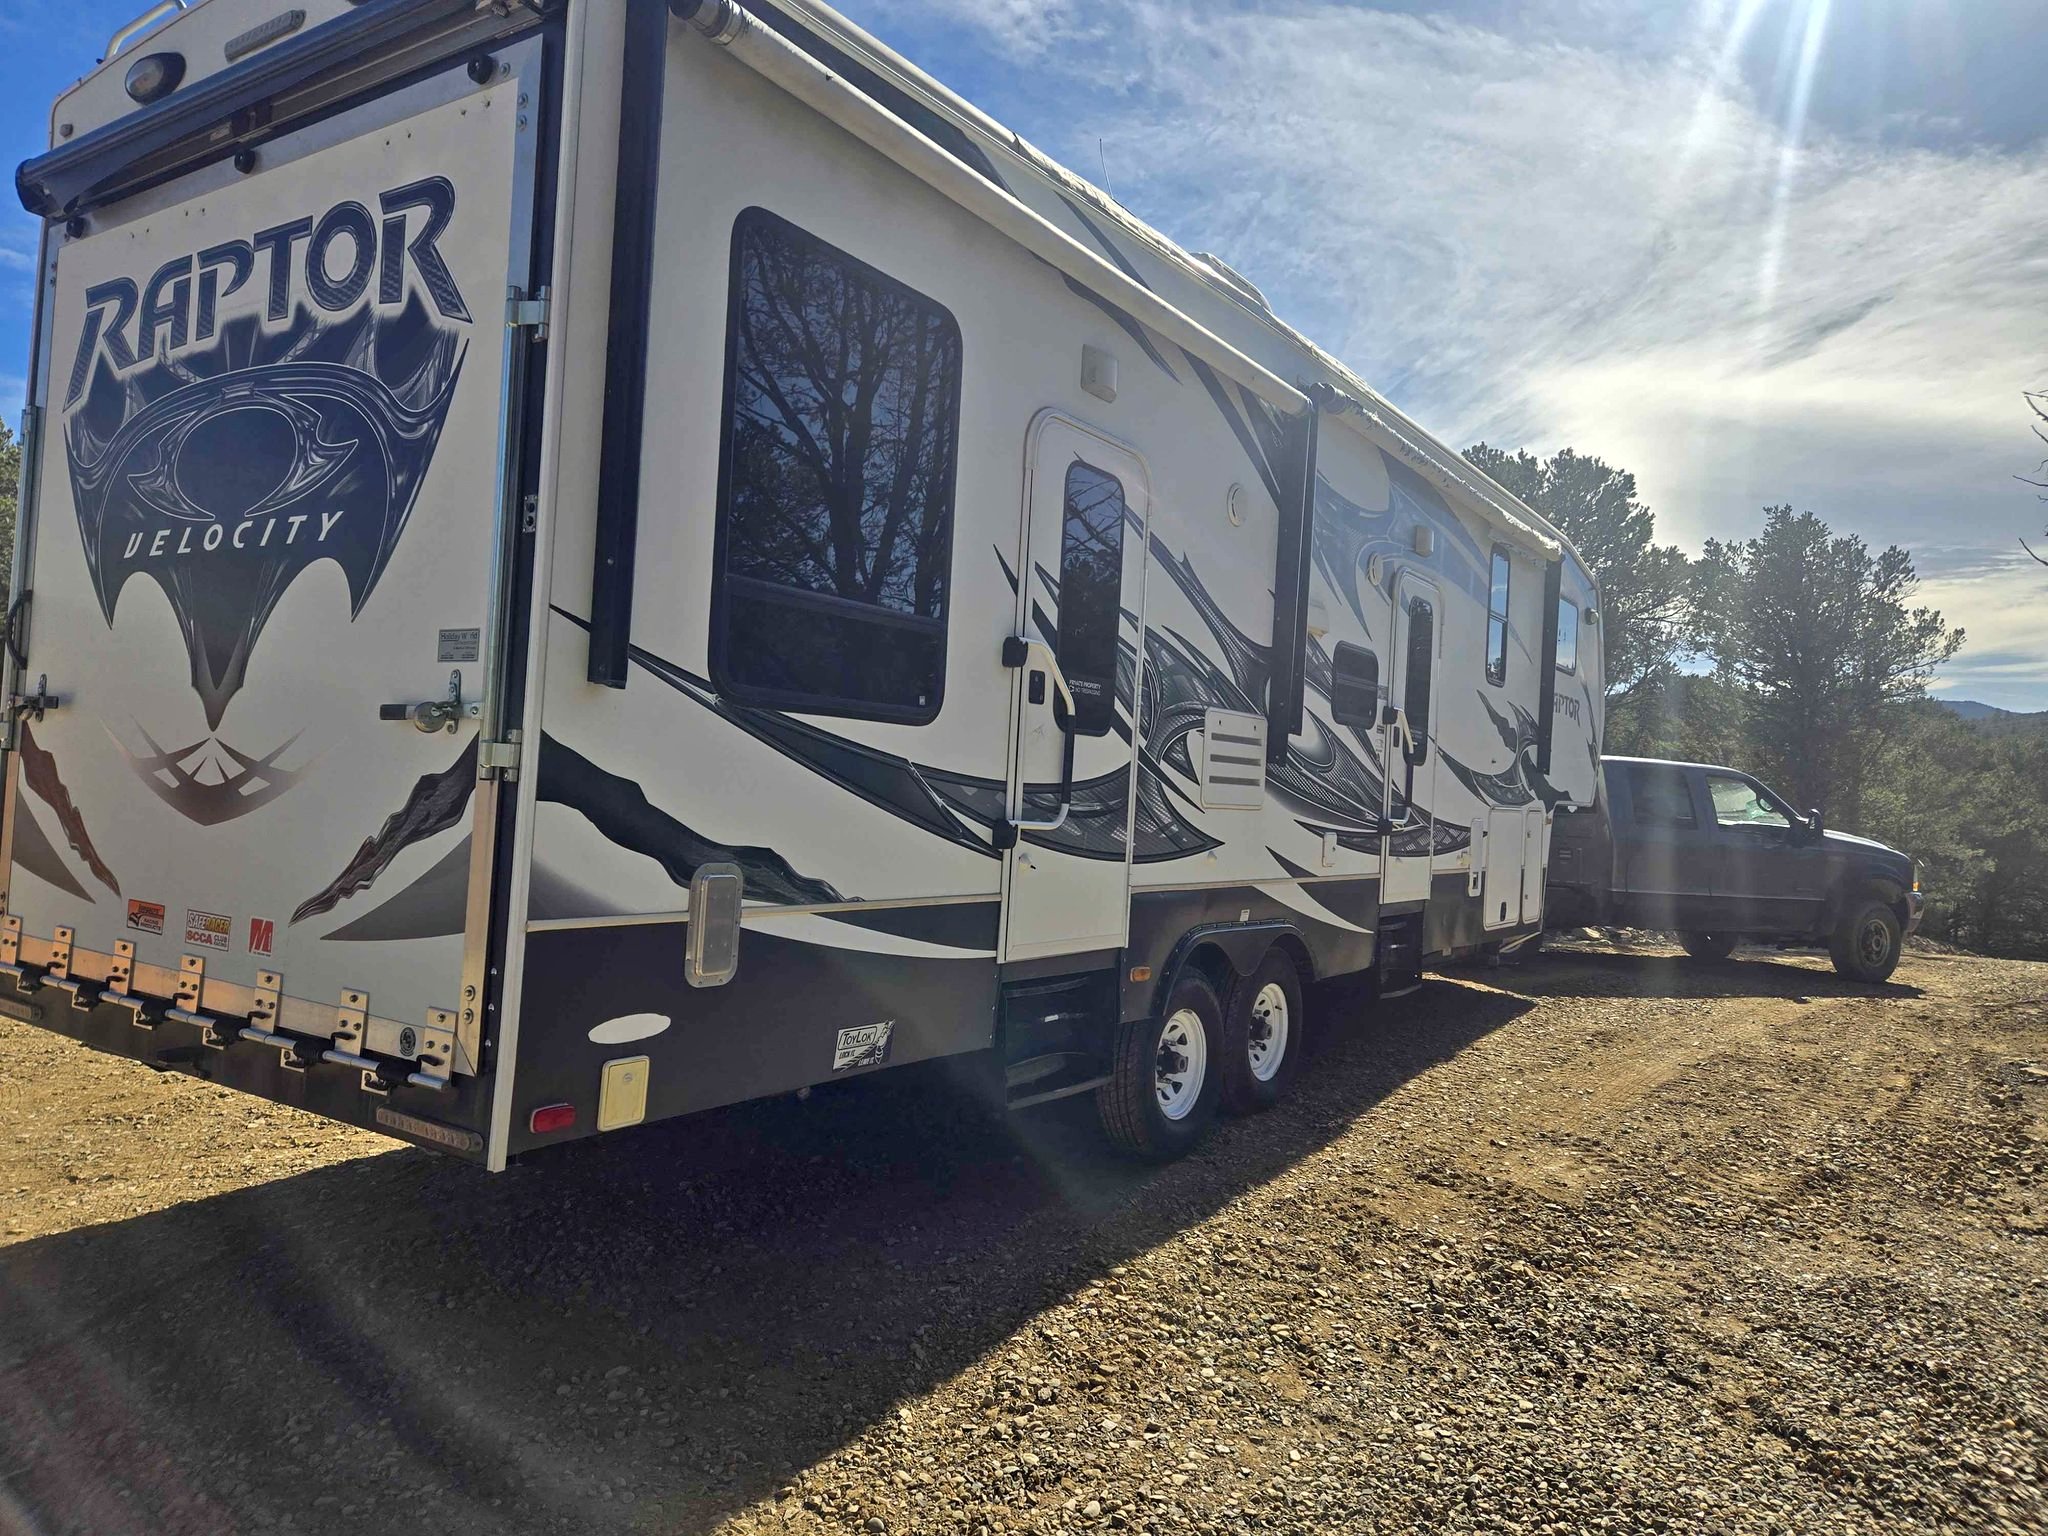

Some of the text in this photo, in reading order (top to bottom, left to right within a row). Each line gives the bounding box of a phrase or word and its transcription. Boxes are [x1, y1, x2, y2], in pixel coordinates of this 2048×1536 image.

[63, 175, 473, 413] RAPTOR
[123, 510, 344, 559] VELOCITY
[441, 631, 460, 641] Holiday
[1553, 692, 1580, 729] APTOR
[186, 929, 213, 945] SCCA
[188, 911, 230, 935] SAFERACER
